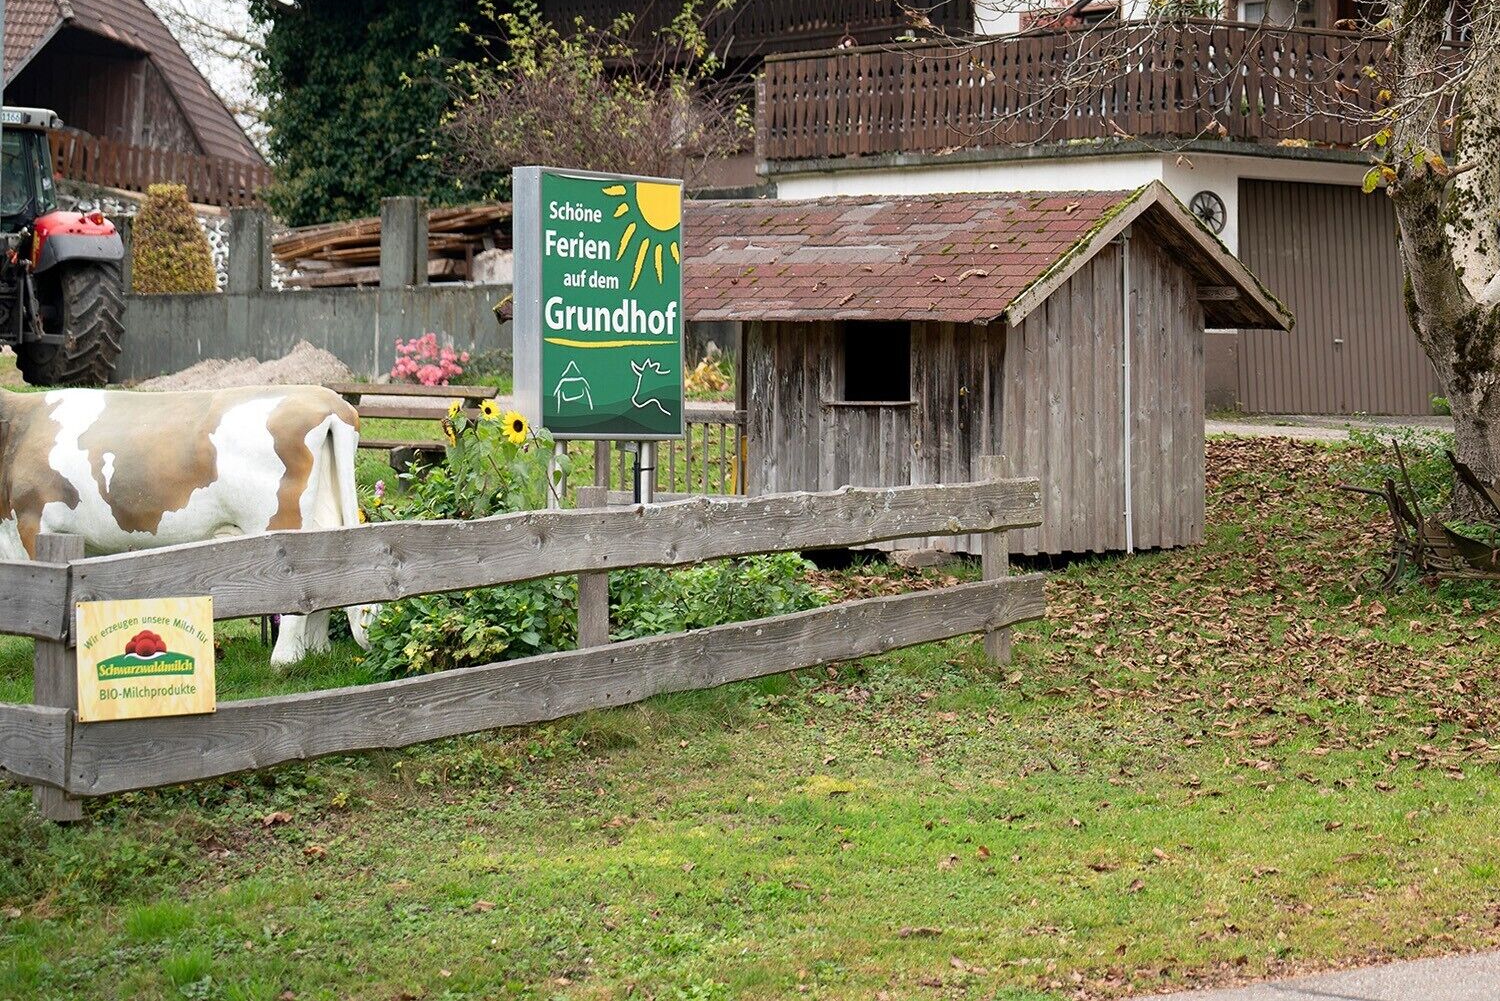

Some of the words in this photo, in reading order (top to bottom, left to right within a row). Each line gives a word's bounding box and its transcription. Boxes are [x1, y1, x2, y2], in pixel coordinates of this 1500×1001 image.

[549, 201, 602, 223] Schöne
[545, 230, 611, 260] Ferien
[563, 269, 587, 287] auf
[589, 271, 619, 289] dem
[545, 296, 677, 335] Grundhof
[84, 634, 99, 649] Wir
[100, 617, 139, 638] erzeugen
[141, 616, 171, 625] unsere
[173, 618, 195, 634] Milch
[196, 630, 209, 644] für
[99, 659, 193, 677] Schwarzwaldmilch
[99, 684, 196, 700] BIO-Milchprodukte
